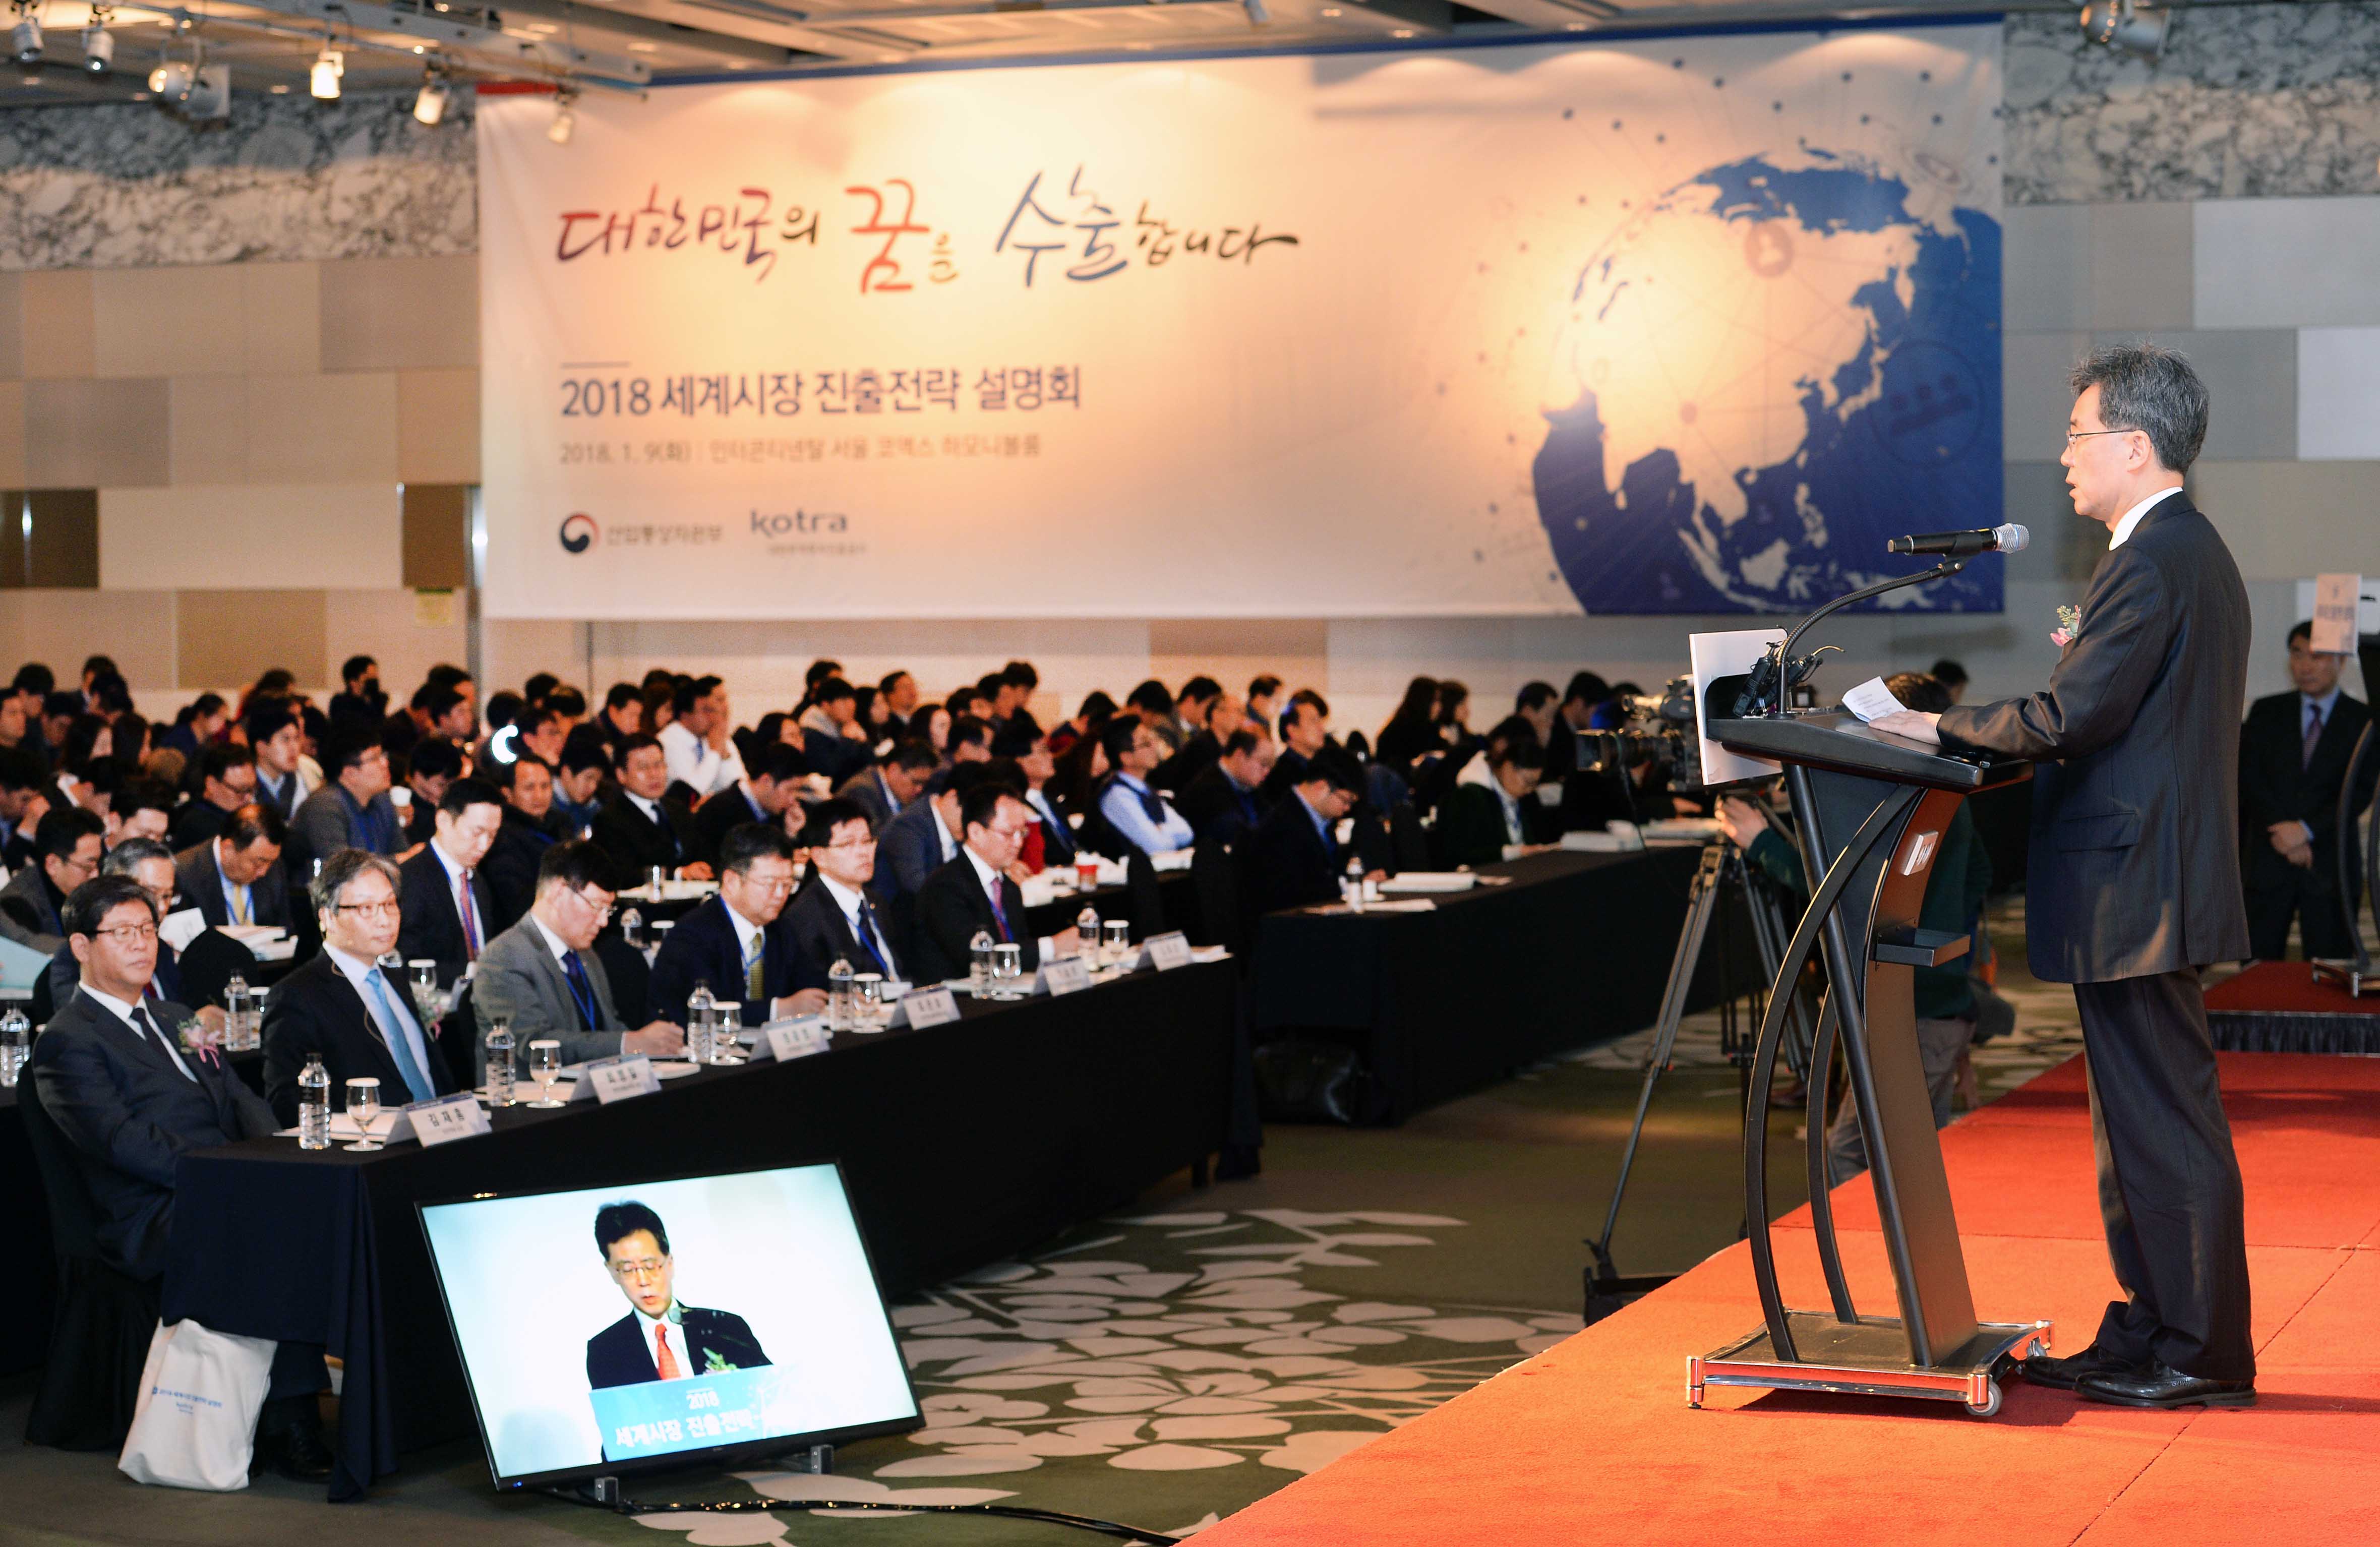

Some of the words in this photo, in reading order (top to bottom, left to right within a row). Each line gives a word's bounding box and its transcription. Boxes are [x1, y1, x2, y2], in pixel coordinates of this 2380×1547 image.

[557, 183, 821, 282] 대한민국의
[845, 178, 959, 294] 꿈을
[995, 163, 1299, 288] 수출합니다
[560, 377, 652, 417] 2018
[660, 372, 804, 417] 세계시장
[814, 366, 962, 414] 진출전략
[974, 364, 1082, 411] 설명회
[750, 508, 849, 538] kotra
[686, 1390, 720, 1409] 2018
[616, 1420, 683, 1448] 세계시장
